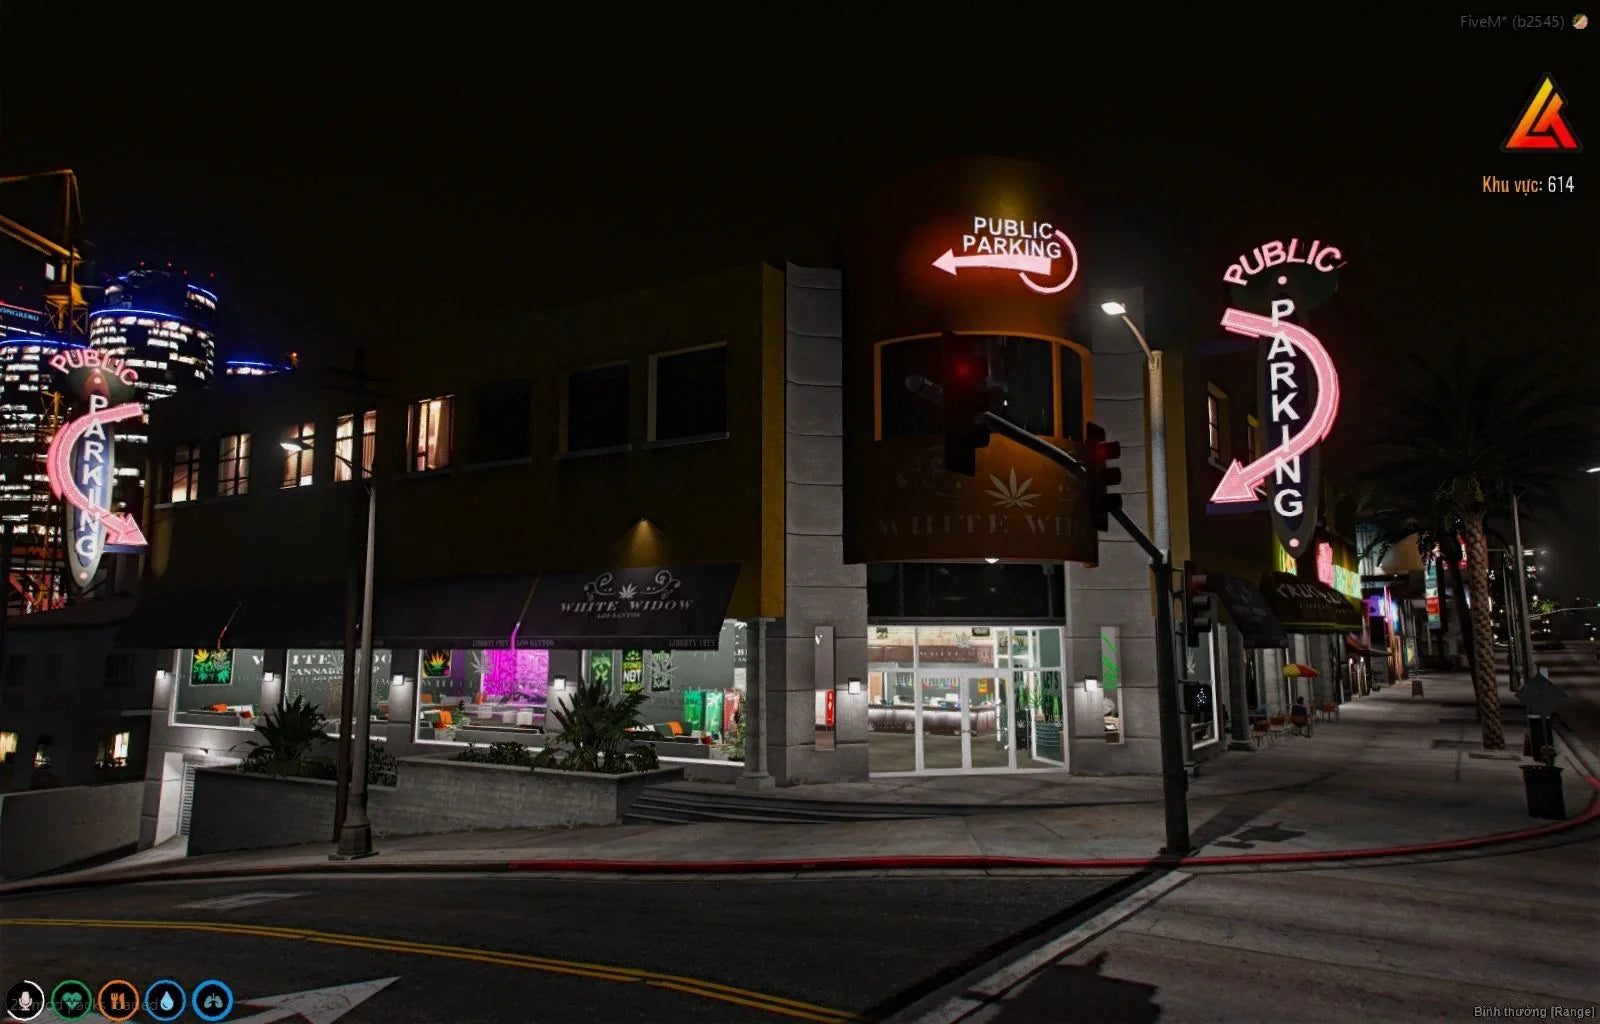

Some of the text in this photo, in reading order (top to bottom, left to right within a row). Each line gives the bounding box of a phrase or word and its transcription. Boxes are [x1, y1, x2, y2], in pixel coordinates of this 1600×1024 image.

[972, 216, 1053, 239] PUBLIC
[962, 234, 1062, 259] PARKING
[1223, 238, 1341, 286] PUBLIC
[49, 348, 139, 386] PUBLIC
[1266, 298, 1304, 517] PARKING
[75, 394, 108, 561] PARKING
[878, 514, 1009, 537] WHITE
[560, 599, 695, 613] WHITE WIDOW
